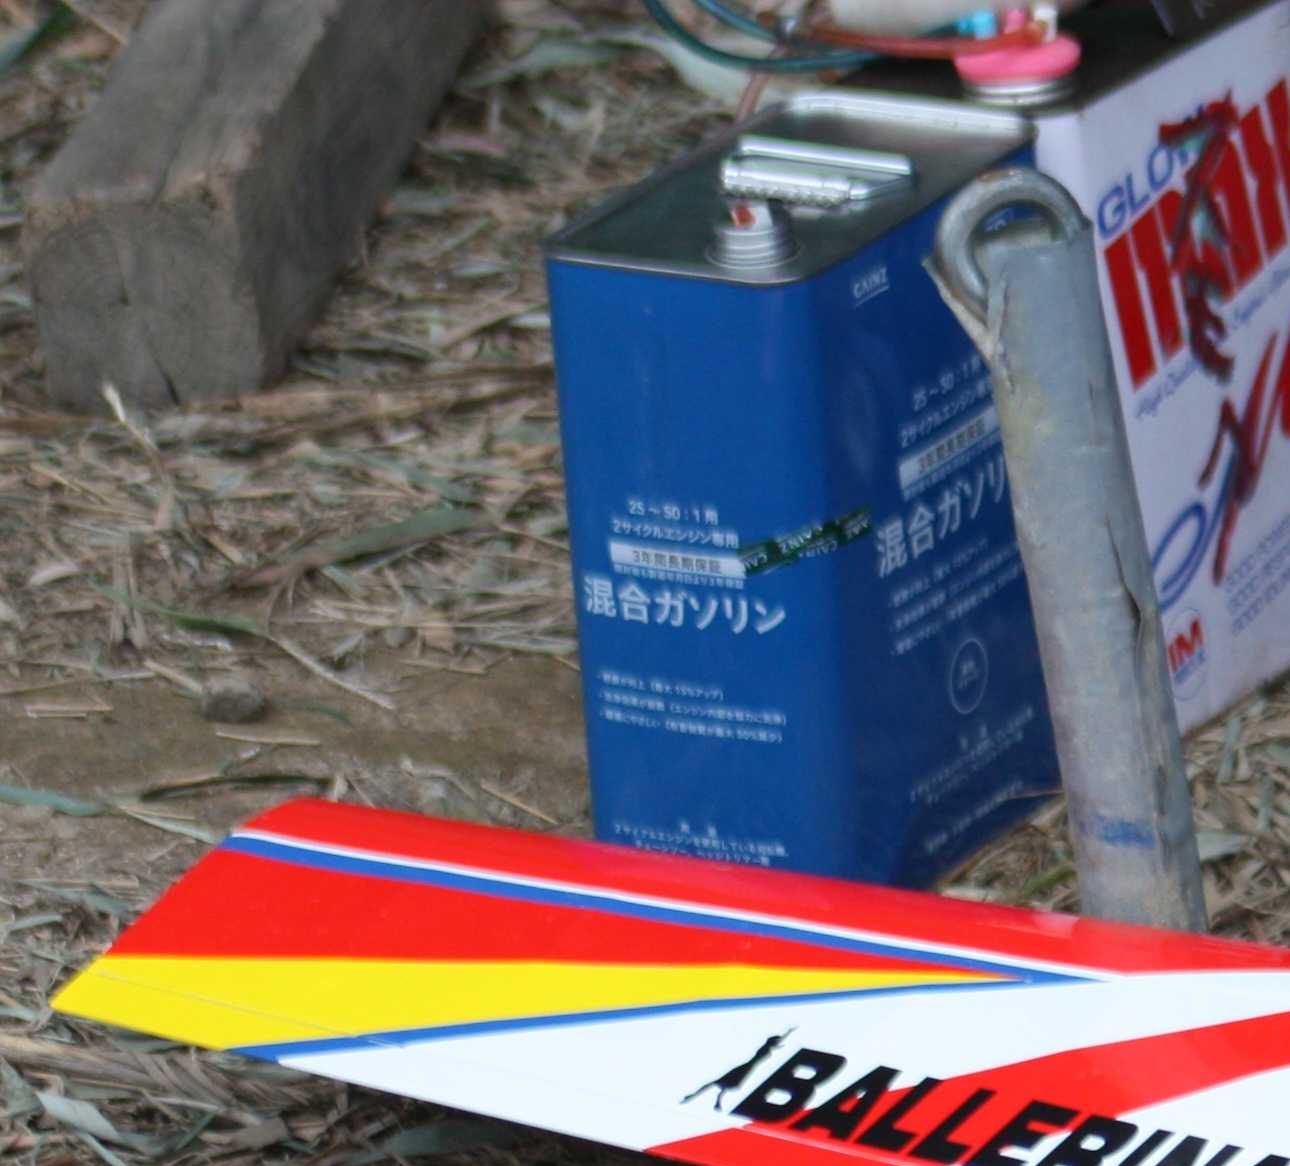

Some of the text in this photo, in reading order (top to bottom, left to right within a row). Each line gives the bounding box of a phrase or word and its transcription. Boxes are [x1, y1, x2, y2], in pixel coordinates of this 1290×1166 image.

[583, 575, 787, 635] 混合ガソリン
